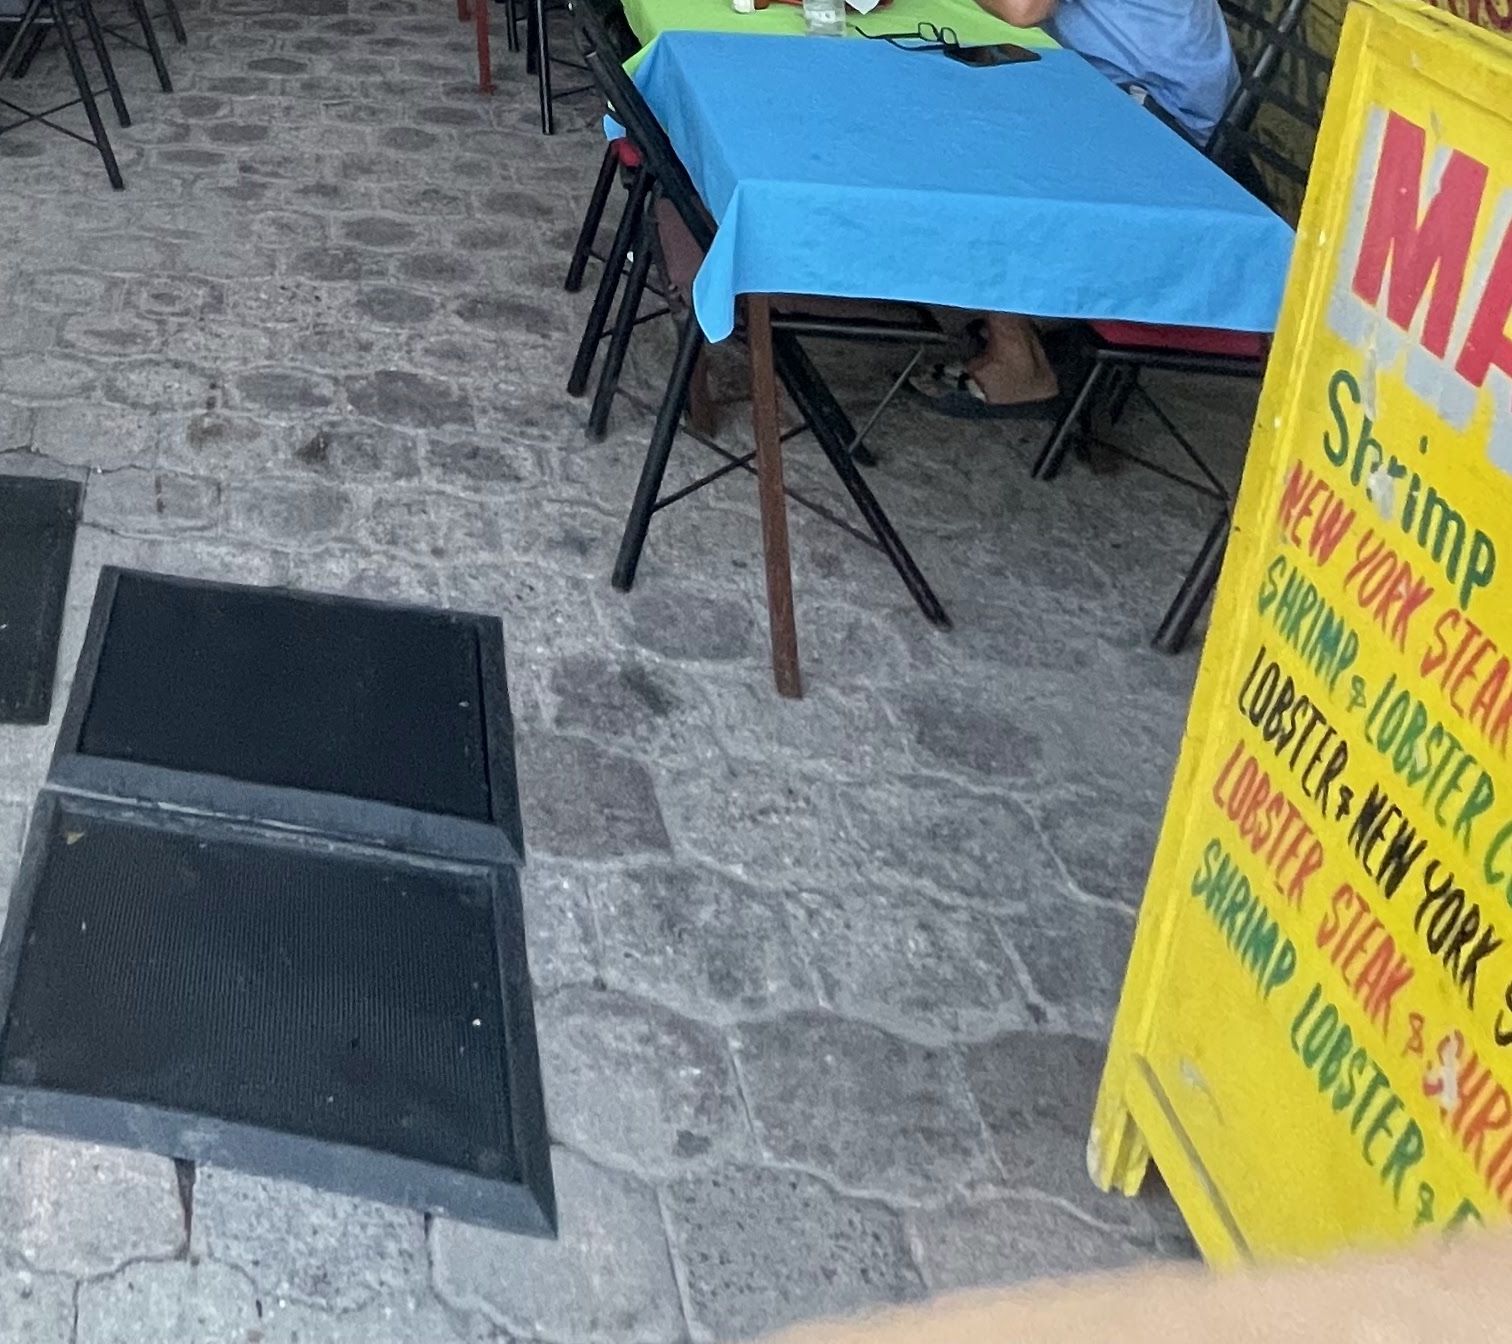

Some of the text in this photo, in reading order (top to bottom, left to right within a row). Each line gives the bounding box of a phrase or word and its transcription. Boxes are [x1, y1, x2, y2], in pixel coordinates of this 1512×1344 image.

[1258, 554, 1359, 700] SHRIMP
[1364, 672, 1496, 855] LOBSTER
[1276, 459, 1356, 567] NEW
[1344, 528, 1435, 654] YORK
[1213, 739, 1324, 912] LOBSTER
[1316, 882, 1414, 1038] STEAK
[1238, 645, 1348, 818] LOBSTER
[1348, 783, 1428, 899] NEW
[1414, 859, 1504, 1010] YORK
[1191, 837, 1297, 1000] SHRIMP
[1289, 983, 1426, 1209] LOBSTER
